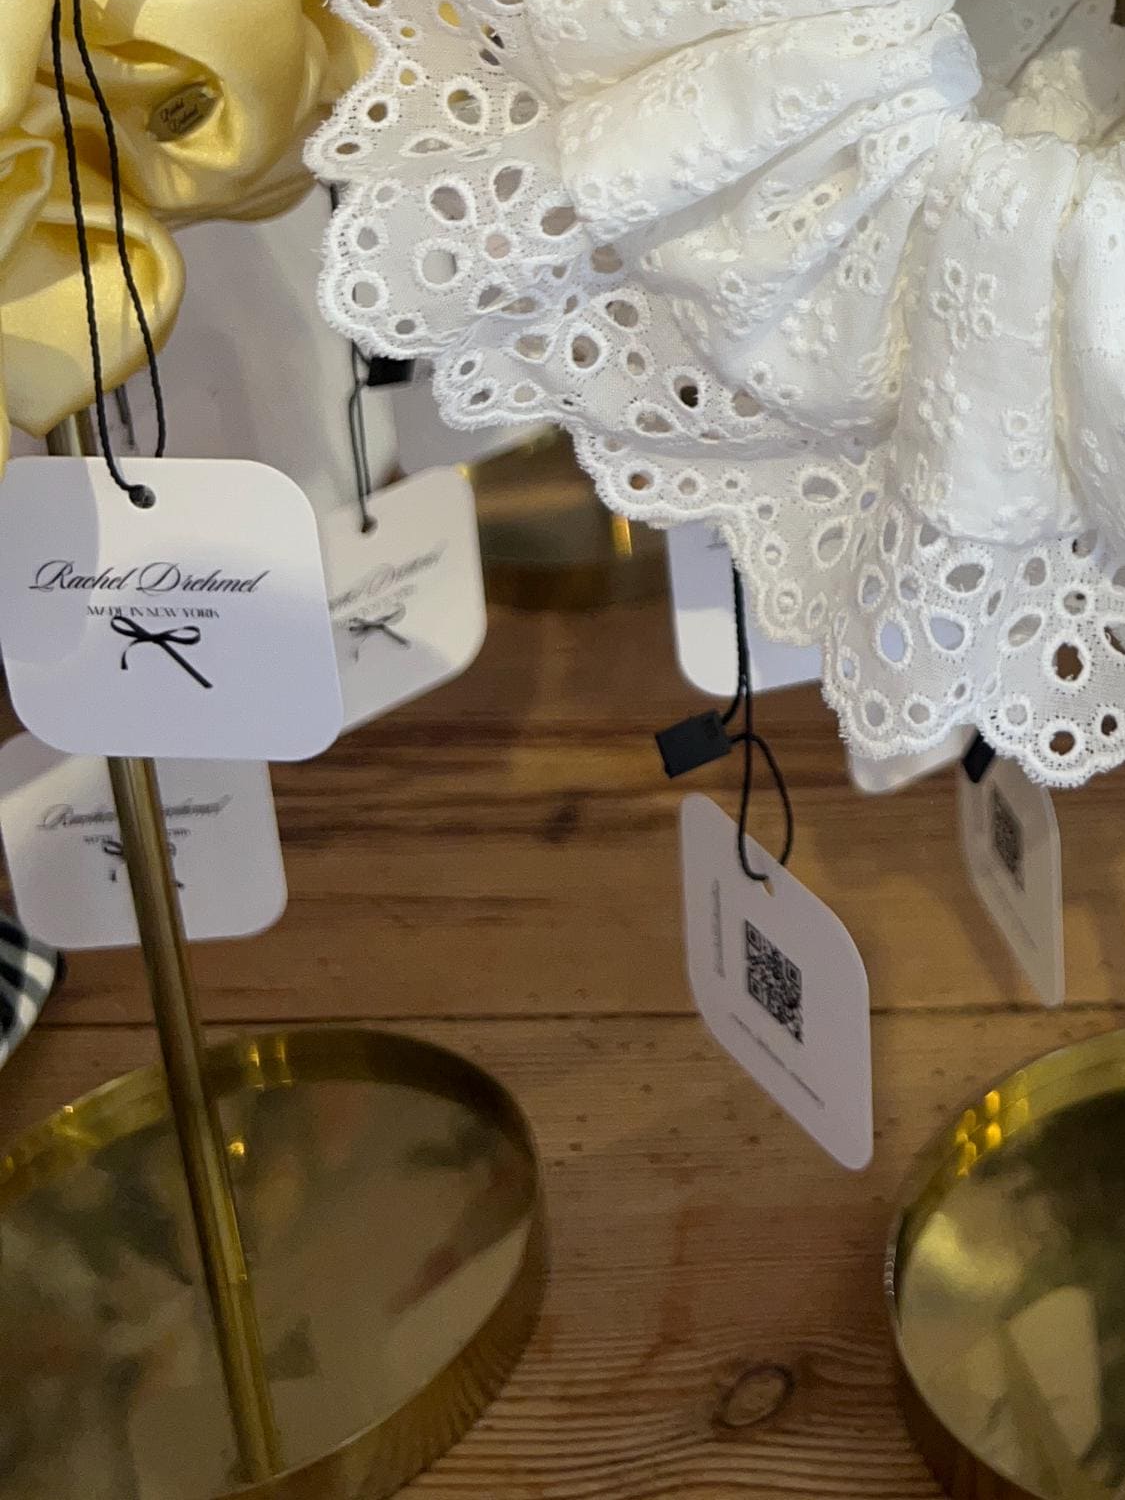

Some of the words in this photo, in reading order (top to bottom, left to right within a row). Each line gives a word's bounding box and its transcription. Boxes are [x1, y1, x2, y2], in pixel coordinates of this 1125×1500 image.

[28, 559, 138, 592] Rachel
[135, 562, 270, 596] Drehmel
[130, 606, 144, 617] IN
[146, 606, 179, 618] NEW
